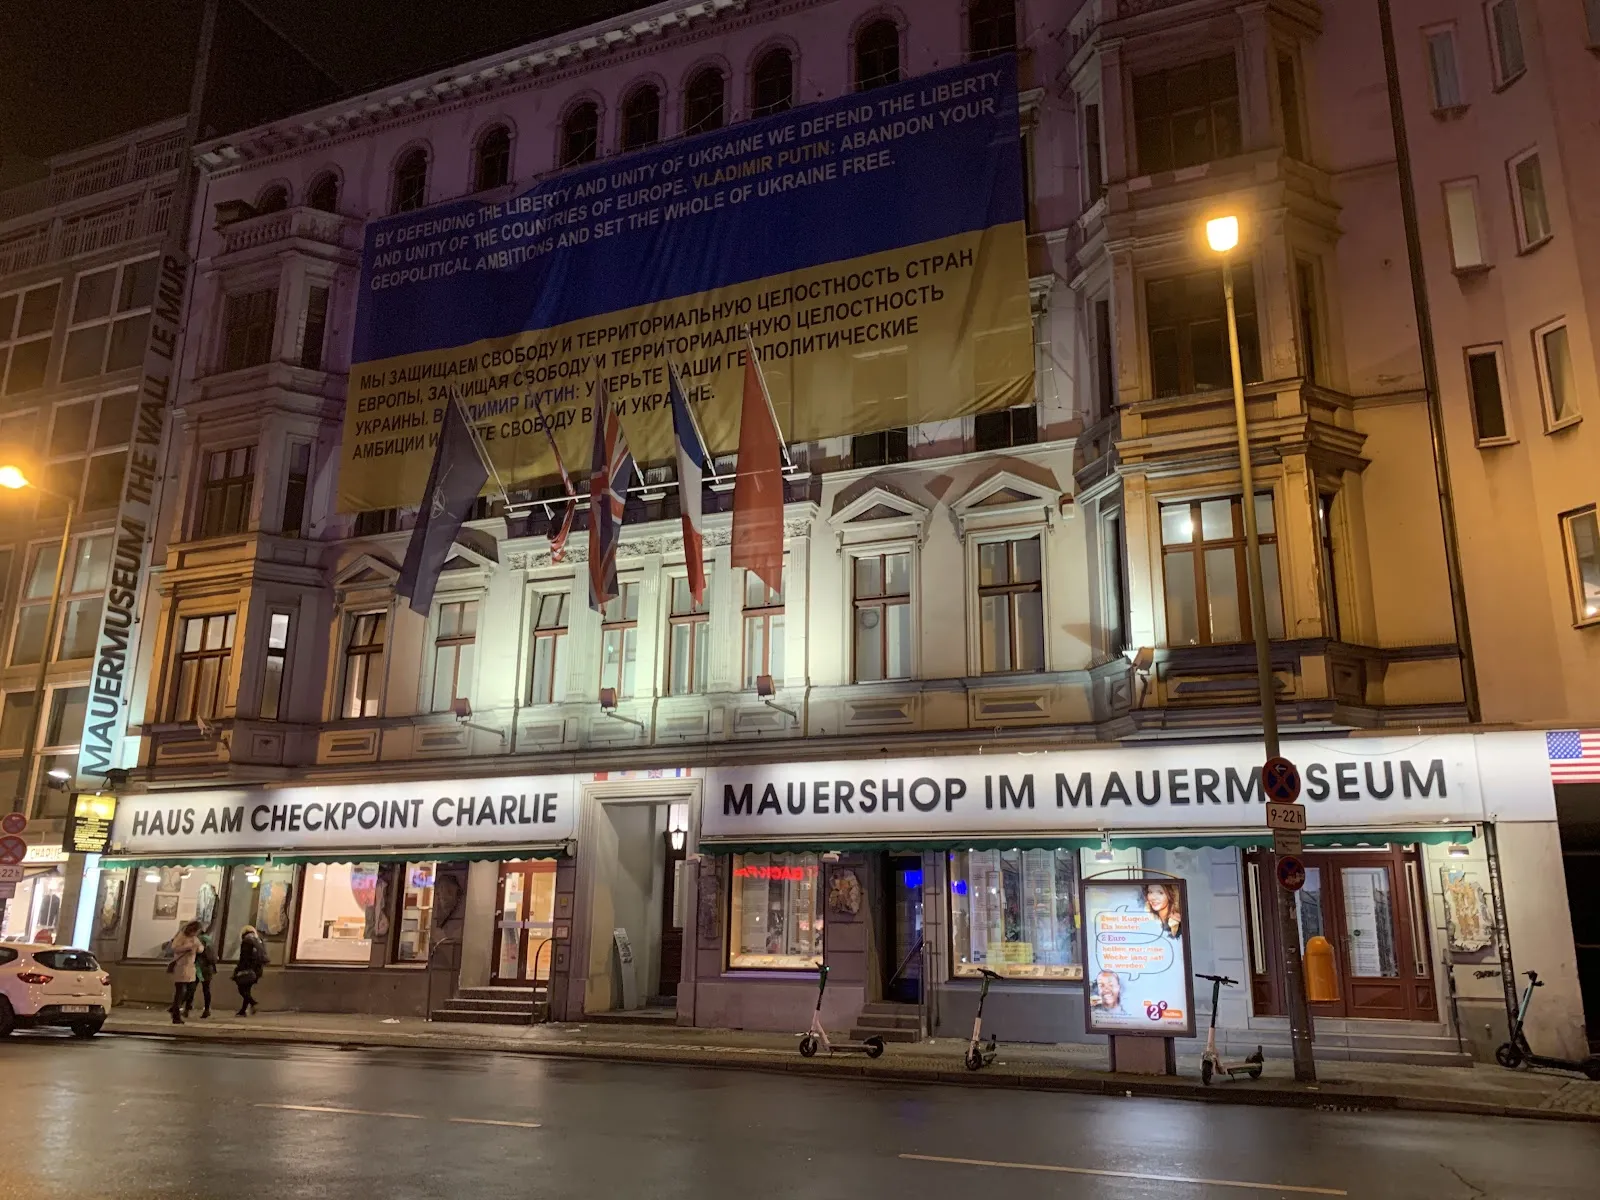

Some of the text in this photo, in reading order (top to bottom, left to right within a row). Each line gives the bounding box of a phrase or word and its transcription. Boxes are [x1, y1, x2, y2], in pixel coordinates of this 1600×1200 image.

[372, 97, 996, 270] AND UNITY OF THE COUNTRIES OF EUROPE. VLADIMIR PUTIN: ABANDON YOUR
[375, 70, 1002, 249] BY DEFENDING THE LIBERTY AND UNITY OF UKRAINE WE DEFEND THE LIBERTY
[370, 149, 896, 291] GEOPOLITICAL AMBITIONS AND SET THE WHOLE OF UKRAINE FREE.
[154, 255, 188, 326] MUR
[360, 248, 974, 390] МЫ ЗАЩИЩАЕМ СВОБОДУ И ТЕРРИТОРИАЛЬНУЮ ЦЕЛОСТНОСТЬ СТРАН
[150, 324, 178, 361] LE
[358, 388, 423, 414] ЕВРОПЫ,
[513, 356, 591, 388] СВОБОДУ
[596, 353, 606, 368] И
[611, 314, 792, 365] ТЕРРИТОРИАЛЬНУЮ
[797, 284, 945, 329] ЦЕЛОСТНОСТЬ
[134, 373, 170, 446] WALL
[352, 434, 425, 461] АМБИЦИИ
[500, 408, 576, 440] СВОБОДУ
[632, 384, 716, 415] УКРАНЕ.
[355, 410, 428, 437] УКРАИНЫ.
[524, 384, 580, 410] ПУТИН:
[125, 448, 157, 506] THE
[81, 514, 147, 778] MAUERMUSEUM
[132, 808, 195, 836] HAUS
[201, 805, 243, 833] AM
[250, 798, 425, 832] CHECKPOINT
[432, 793, 558, 828] CHARLIE
[722, 760, 1447, 817] MAUERSHOP IM MAUERMSEUM
[1271, 809, 1294, 823] 9-22
